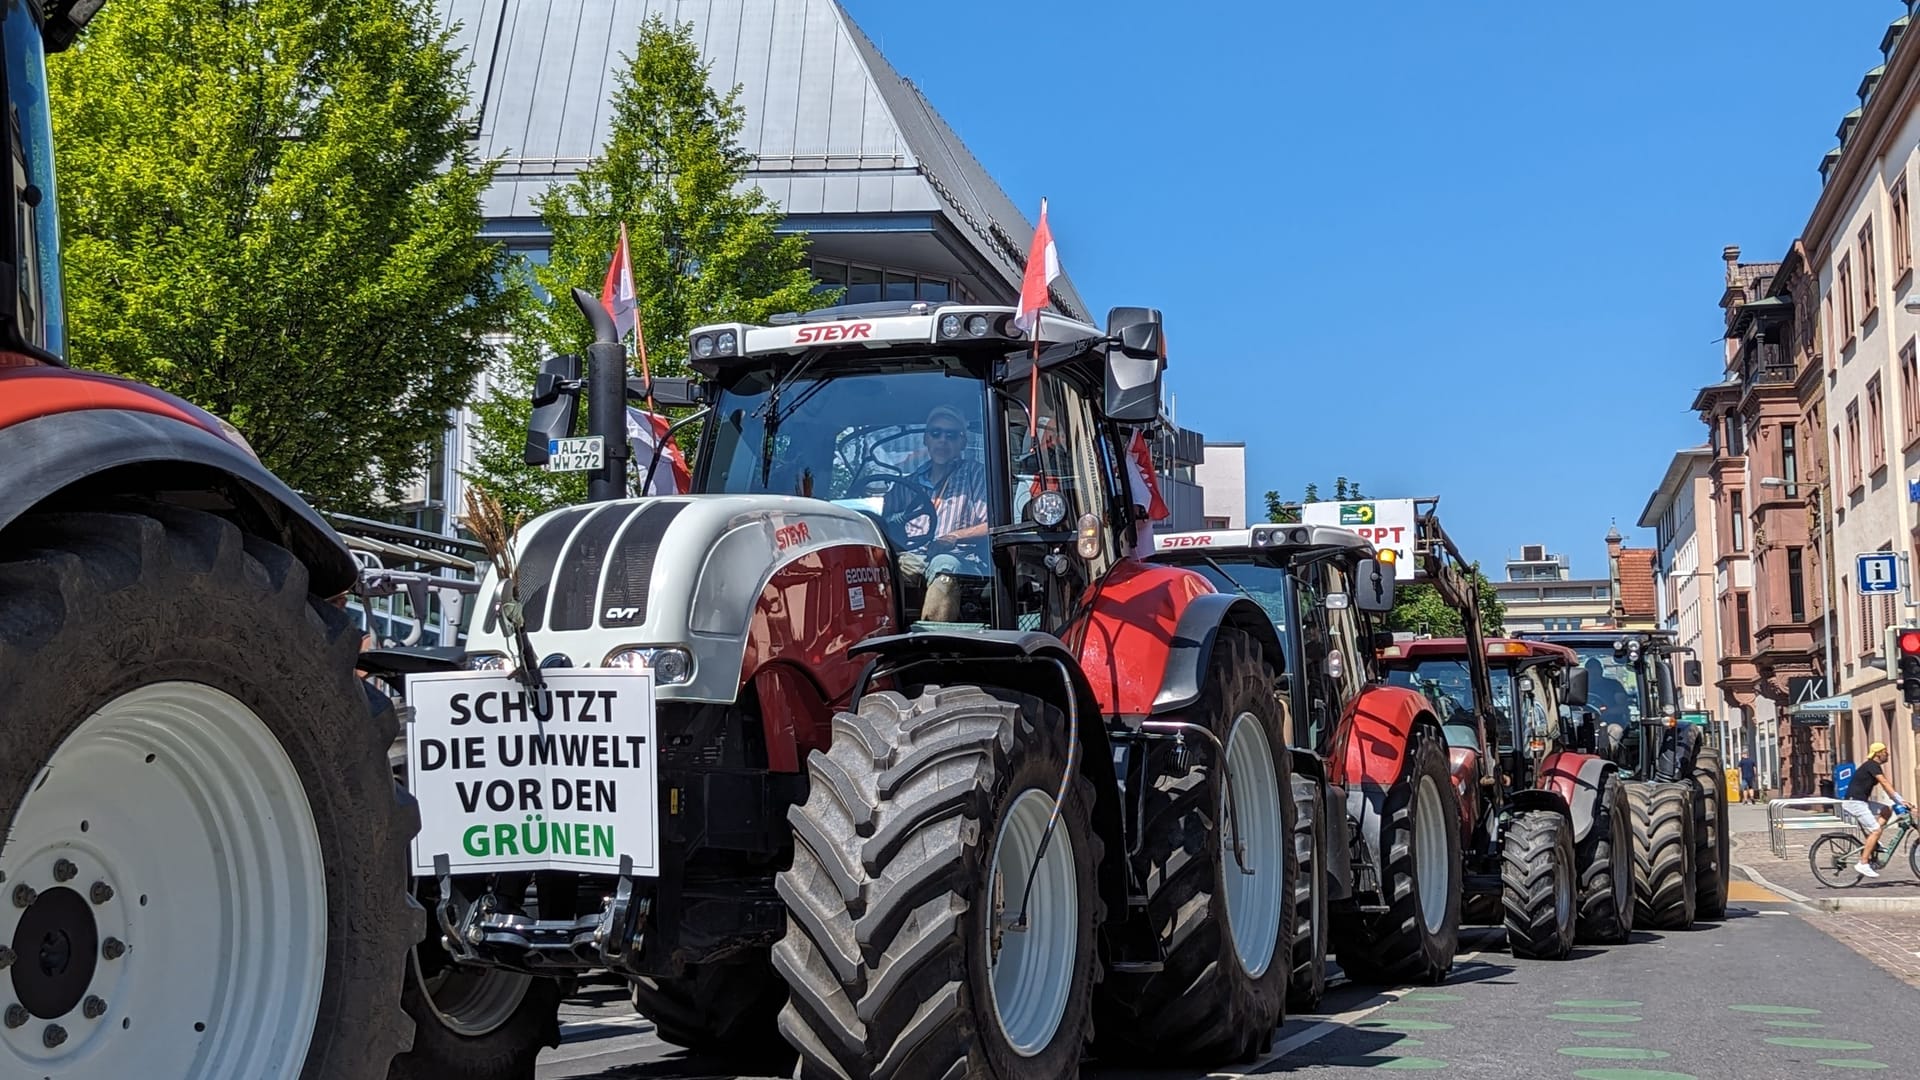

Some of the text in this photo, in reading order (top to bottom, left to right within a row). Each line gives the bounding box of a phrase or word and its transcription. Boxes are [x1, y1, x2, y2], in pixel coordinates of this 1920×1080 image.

[795, 323, 872, 343] STEYR
[562, 440, 587, 455] ALZ
[553, 453, 600, 470] WW 272
[776, 521, 811, 550] STEYR
[1162, 536, 1212, 547] STEYR
[606, 607, 639, 618] CVT
[450, 683, 617, 725] SCHÜTZT
[420, 734, 646, 771] DIE UMWELT
[456, 778, 617, 813] VOR DEN
[463, 814, 614, 857] GRÜNEN
